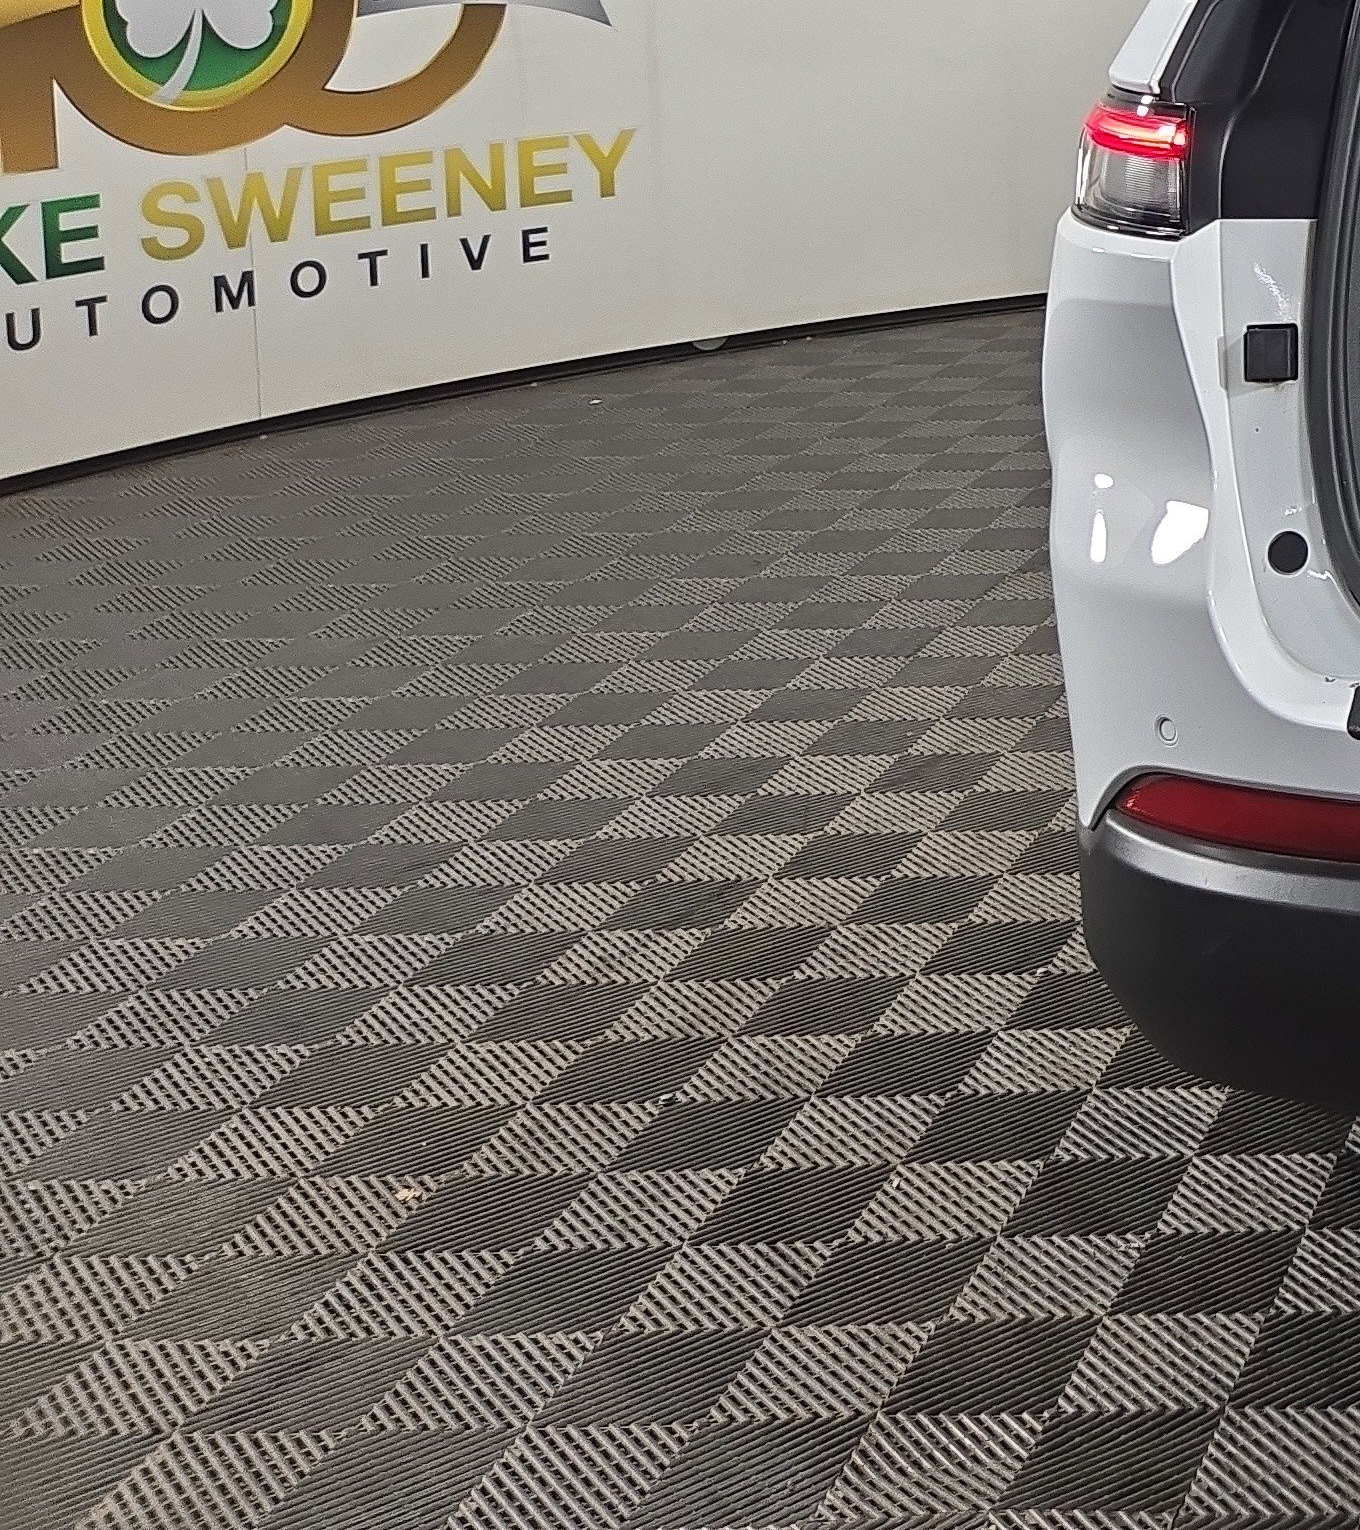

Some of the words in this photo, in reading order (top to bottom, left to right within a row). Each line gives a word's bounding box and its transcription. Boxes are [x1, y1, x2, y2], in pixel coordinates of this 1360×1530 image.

[0, 193, 106, 286] KE
[139, 127, 638, 262] SWEENEY
[4, 226, 550, 352] UTOMOTIVE
